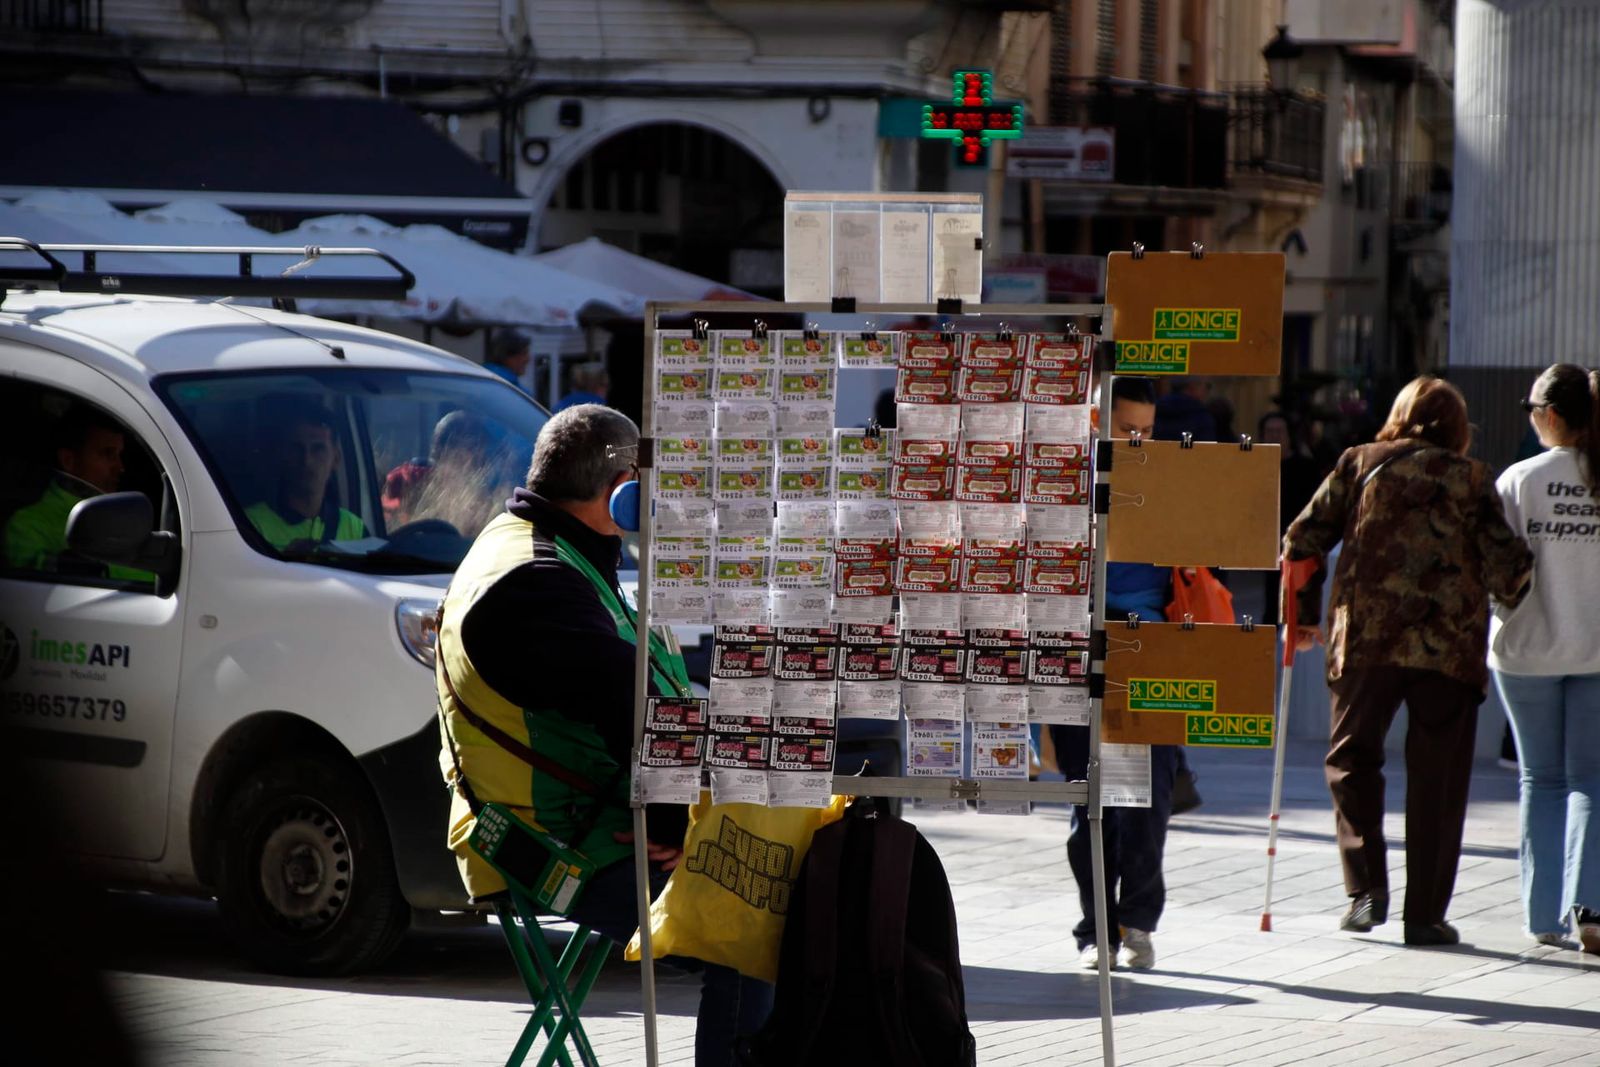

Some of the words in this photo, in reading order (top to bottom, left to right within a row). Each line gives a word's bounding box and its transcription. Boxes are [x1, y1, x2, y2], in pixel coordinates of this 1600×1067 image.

[1175, 313, 1237, 328] ONCE
[1124, 345, 1186, 361] ONCE
[1548, 481, 1585, 498] the
[1527, 518, 1543, 534] is
[31, 628, 130, 668] imesAPI
[723, 660, 746, 668] BLACK
[786, 662, 809, 670] BLACK
[912, 663, 937, 671] BLACK
[977, 665, 1001, 674] BLACK
[1039, 666, 1063, 674] BLACK
[1150, 683, 1213, 699] ONCE
[656, 714, 680, 722] BLACK
[1207, 718, 1271, 734] ONCE
[653, 749, 676, 757] BLACK
[716, 750, 741, 758] BLACK
[718, 815, 794, 880] EURO
